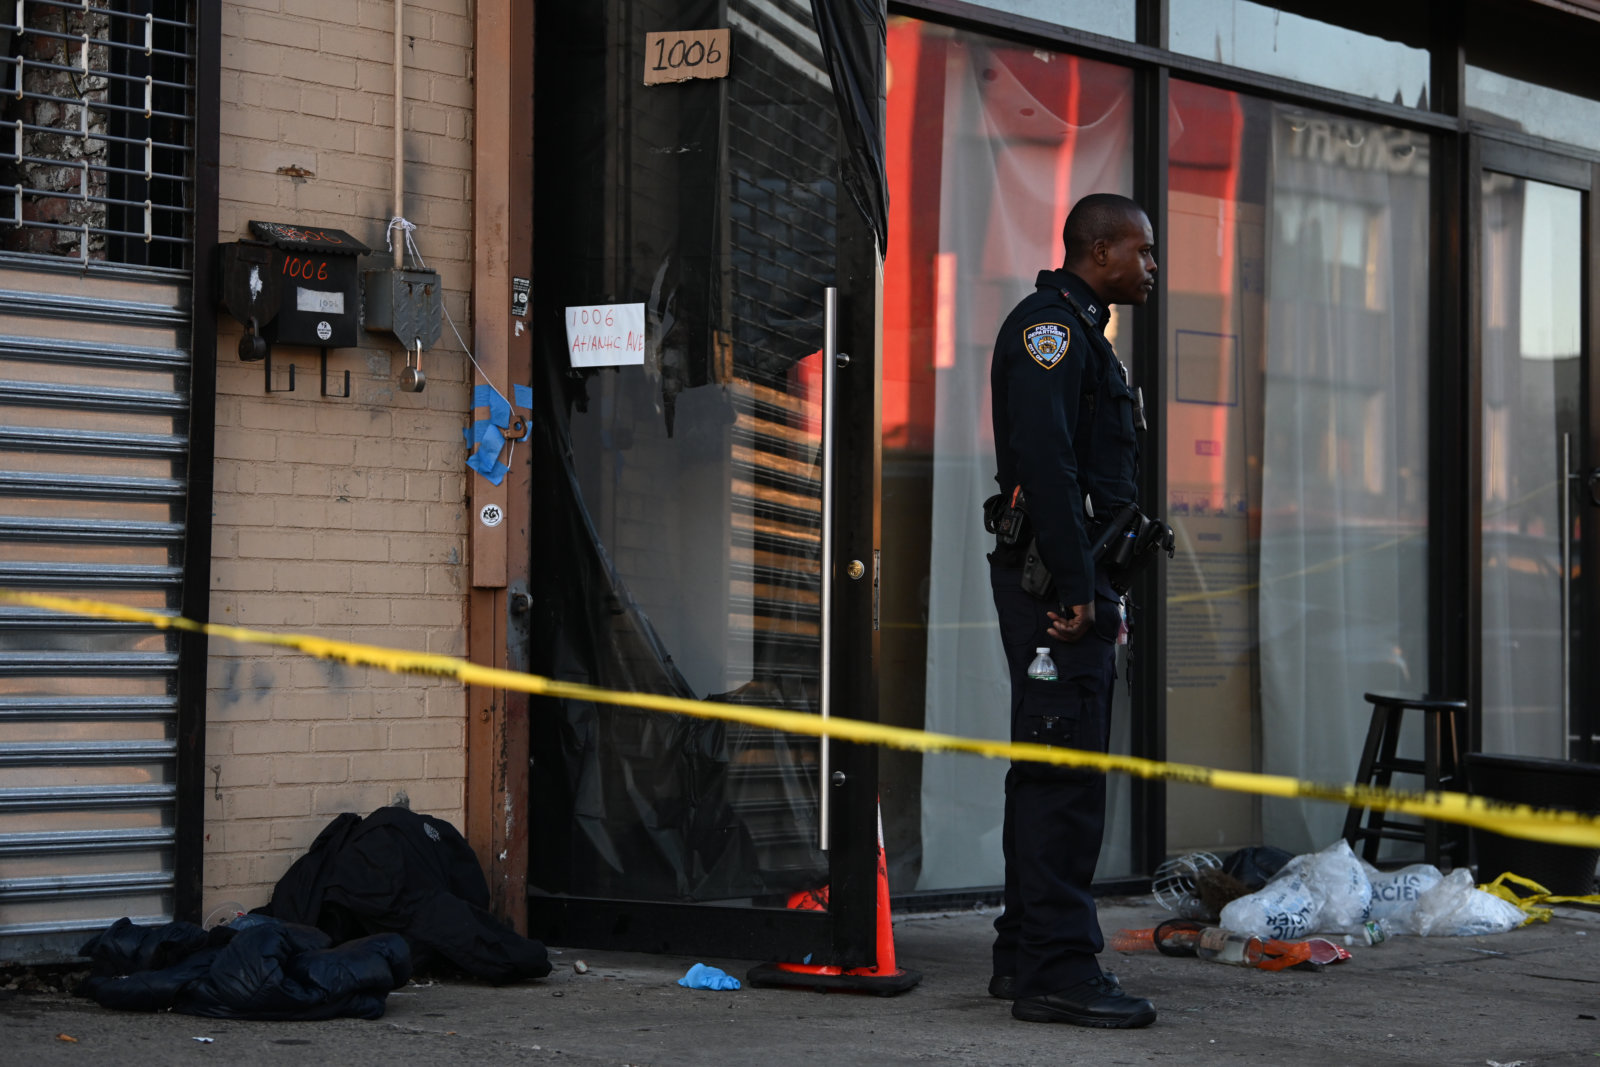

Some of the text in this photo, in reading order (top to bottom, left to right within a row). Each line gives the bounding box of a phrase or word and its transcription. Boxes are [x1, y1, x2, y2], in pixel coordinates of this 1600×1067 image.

[652, 37, 722, 71] 1006
[282, 255, 328, 280] 1006
[572, 308, 614, 327] 1006
[626, 330, 645, 352] AVE
[1027, 330, 1066, 339] DEPARTMENT
[1028, 343, 1038, 355] CITY
